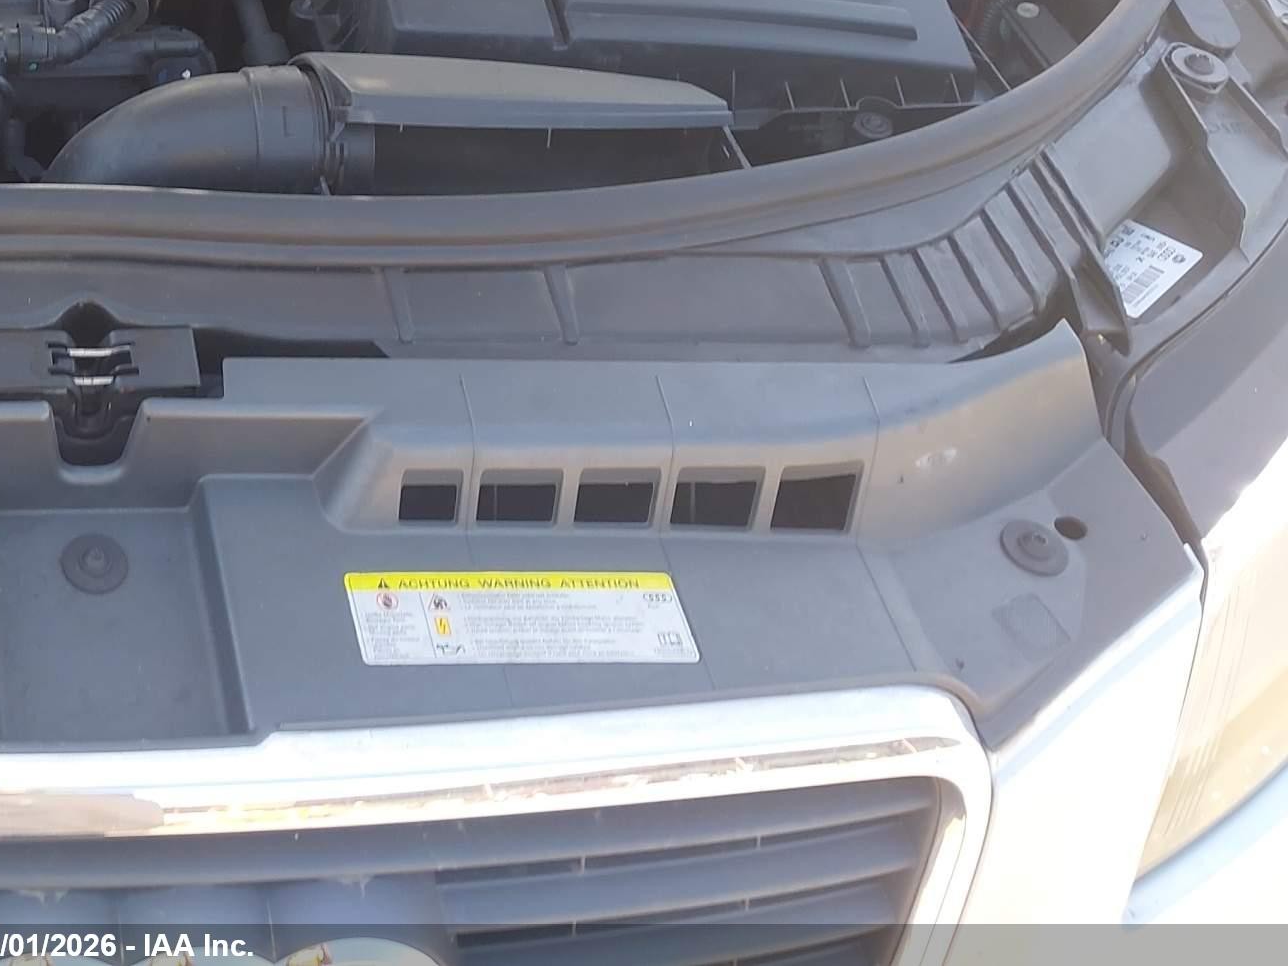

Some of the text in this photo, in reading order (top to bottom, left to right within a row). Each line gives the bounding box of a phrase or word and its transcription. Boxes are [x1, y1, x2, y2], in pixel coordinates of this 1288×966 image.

[398, 577, 640, 589] ACHTUNG WARNING ATTENTION
